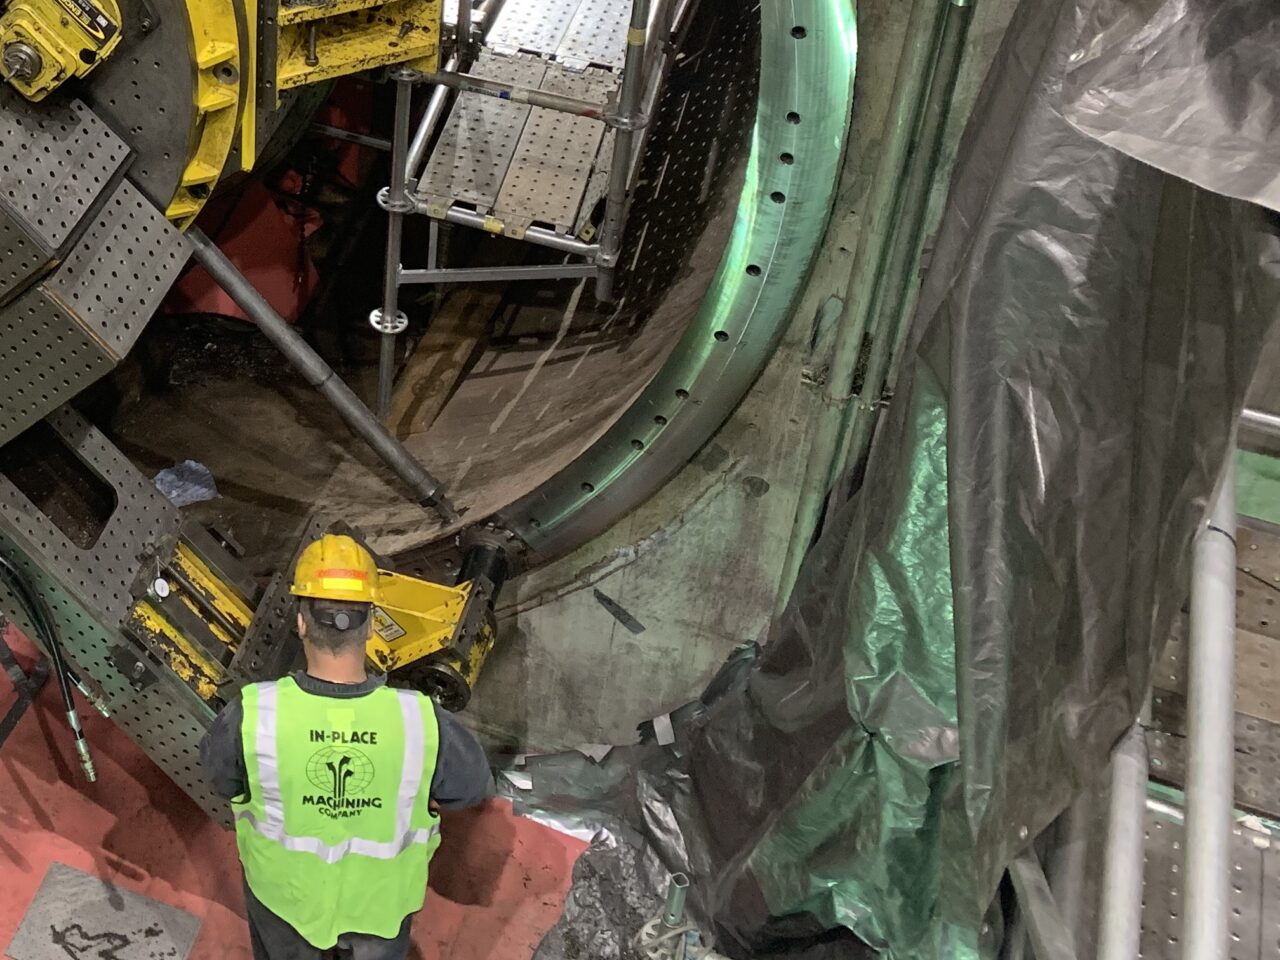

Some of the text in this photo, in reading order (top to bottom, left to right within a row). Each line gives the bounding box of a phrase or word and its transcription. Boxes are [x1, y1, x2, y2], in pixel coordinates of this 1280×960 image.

[310, 730, 377, 744] IN-PLACE
[302, 795, 382, 811] MACHINING
[318, 807, 363, 820] COMPANY
